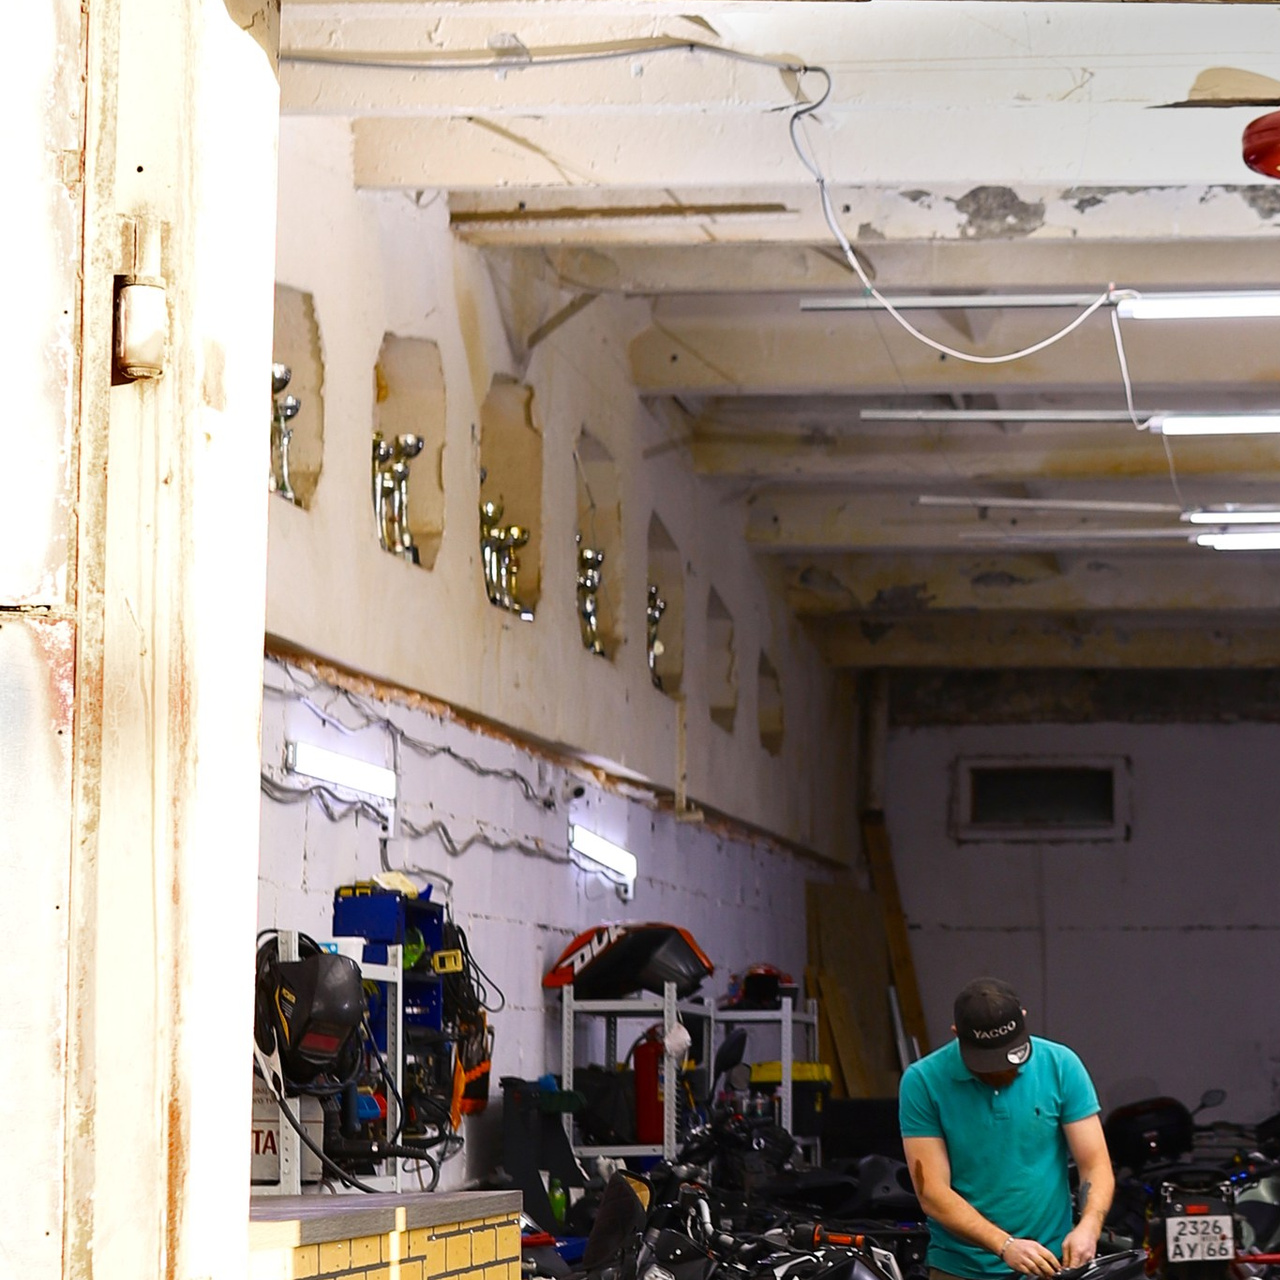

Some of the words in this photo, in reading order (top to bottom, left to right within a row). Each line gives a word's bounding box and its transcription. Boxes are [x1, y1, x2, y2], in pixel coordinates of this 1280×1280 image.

[973, 1020, 1017, 1039] YACCO
[1177, 1220, 1222, 1236] 2326
[1207, 1242, 1229, 1257] 66
